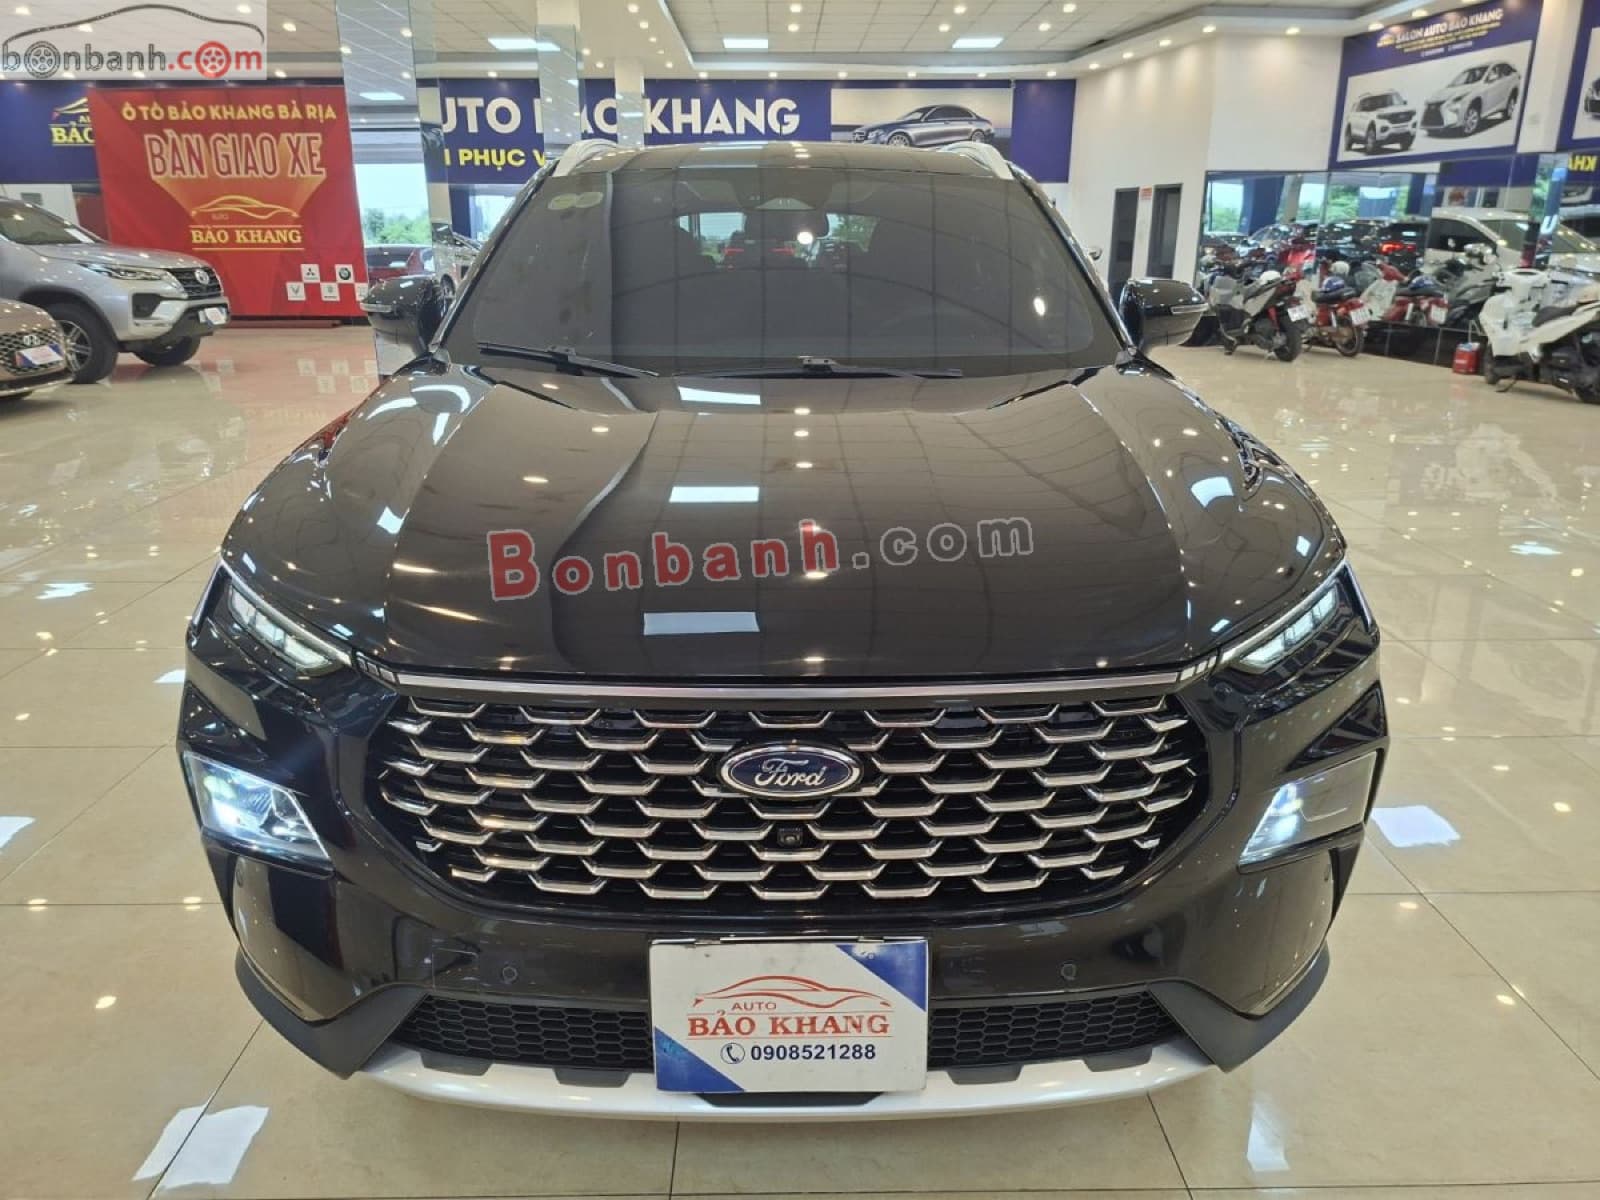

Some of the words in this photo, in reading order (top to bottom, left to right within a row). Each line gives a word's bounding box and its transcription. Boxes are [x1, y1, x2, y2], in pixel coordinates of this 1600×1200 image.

[121, 102, 136, 121] Ô
[209, 104, 275, 120] KHANG
[277, 100, 301, 120] BÀ
[643, 97, 800, 136] KHANG
[144, 128, 208, 179] BÀN
[210, 132, 280, 178] GIAO
[285, 132, 327, 178] XE
[458, 148, 526, 171] PHỤC
[235, 229, 302, 243] KHANG
[753, 758, 826, 787] Ford
[731, 1001, 777, 1011] AUTO
[687, 1010, 756, 1036] BẢO
[768, 1015, 890, 1035] KHANG
[751, 1044, 876, 1060] 0908521288
